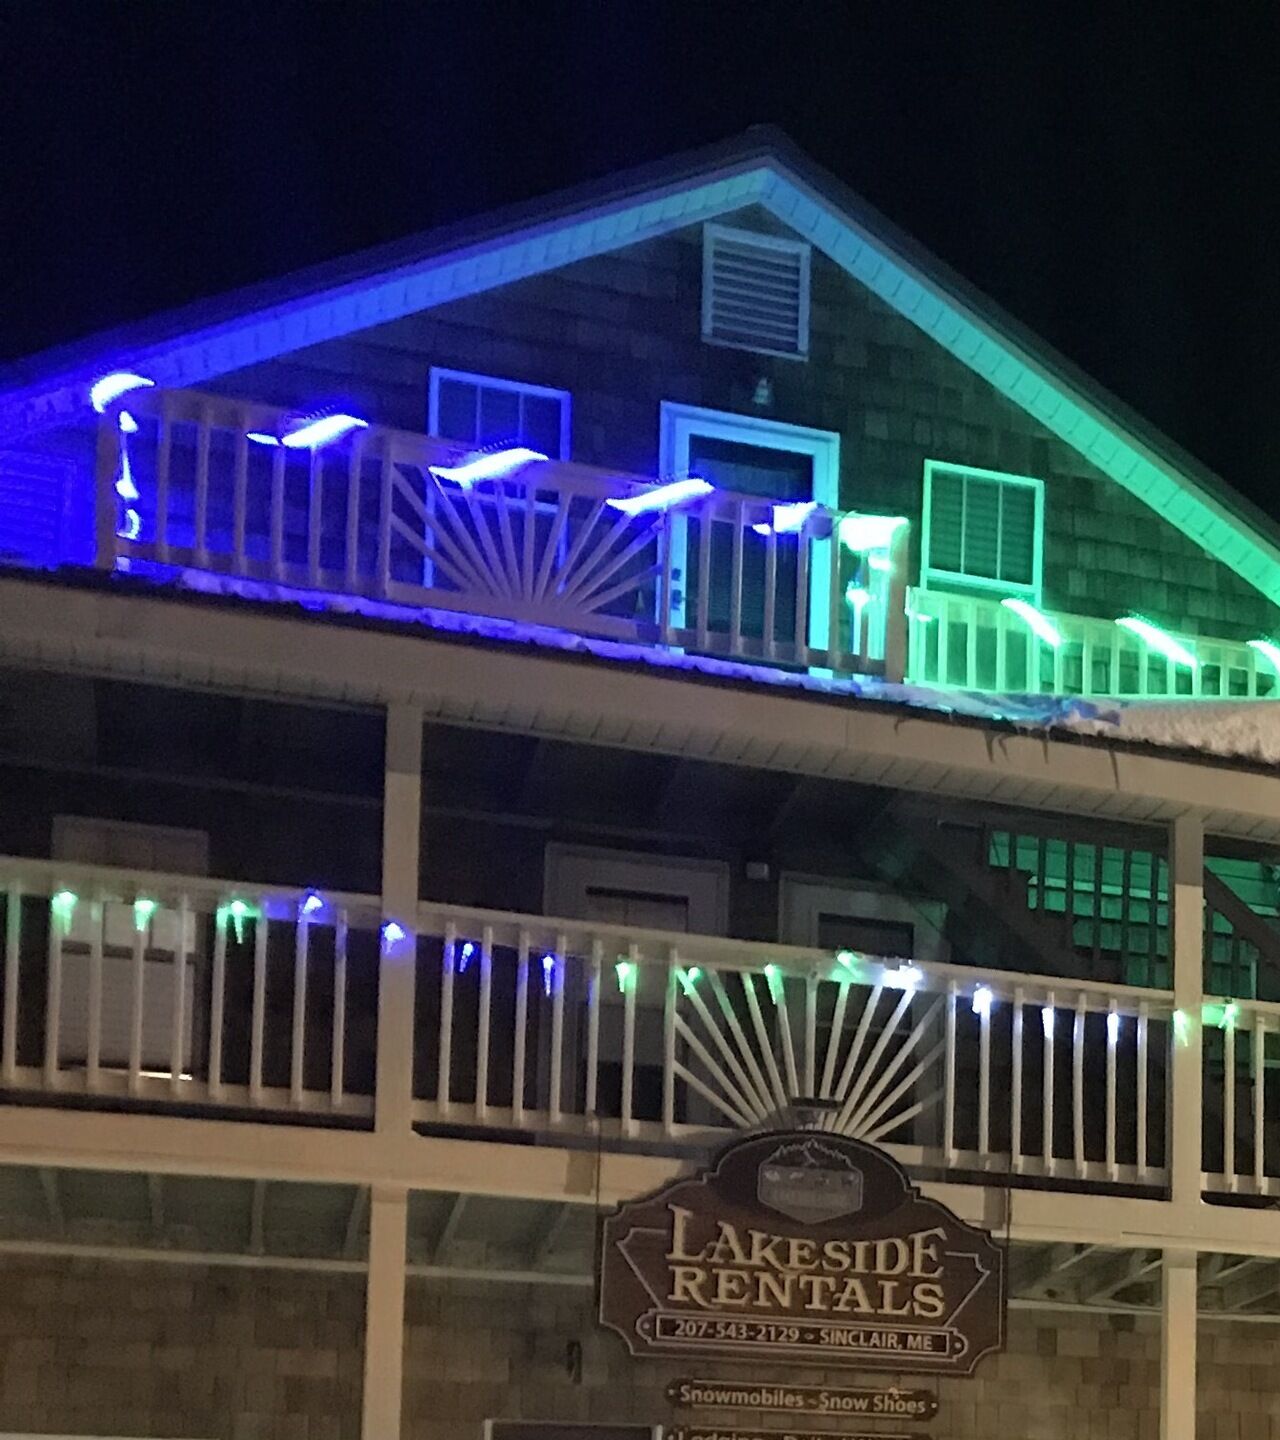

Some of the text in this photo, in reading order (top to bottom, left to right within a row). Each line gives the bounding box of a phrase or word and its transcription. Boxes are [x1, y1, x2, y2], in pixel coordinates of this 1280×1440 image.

[664, 1202, 948, 1279] LAKESIDE
[667, 1264, 946, 1318] RENTALS
[674, 1319, 934, 1352] 207-543-2129 SINCLAIR, ME
[679, 1384, 805, 1407] Snowmobiles
[818, 1391, 869, 1412] Snow
[872, 1395, 927, 1415] Shoes
